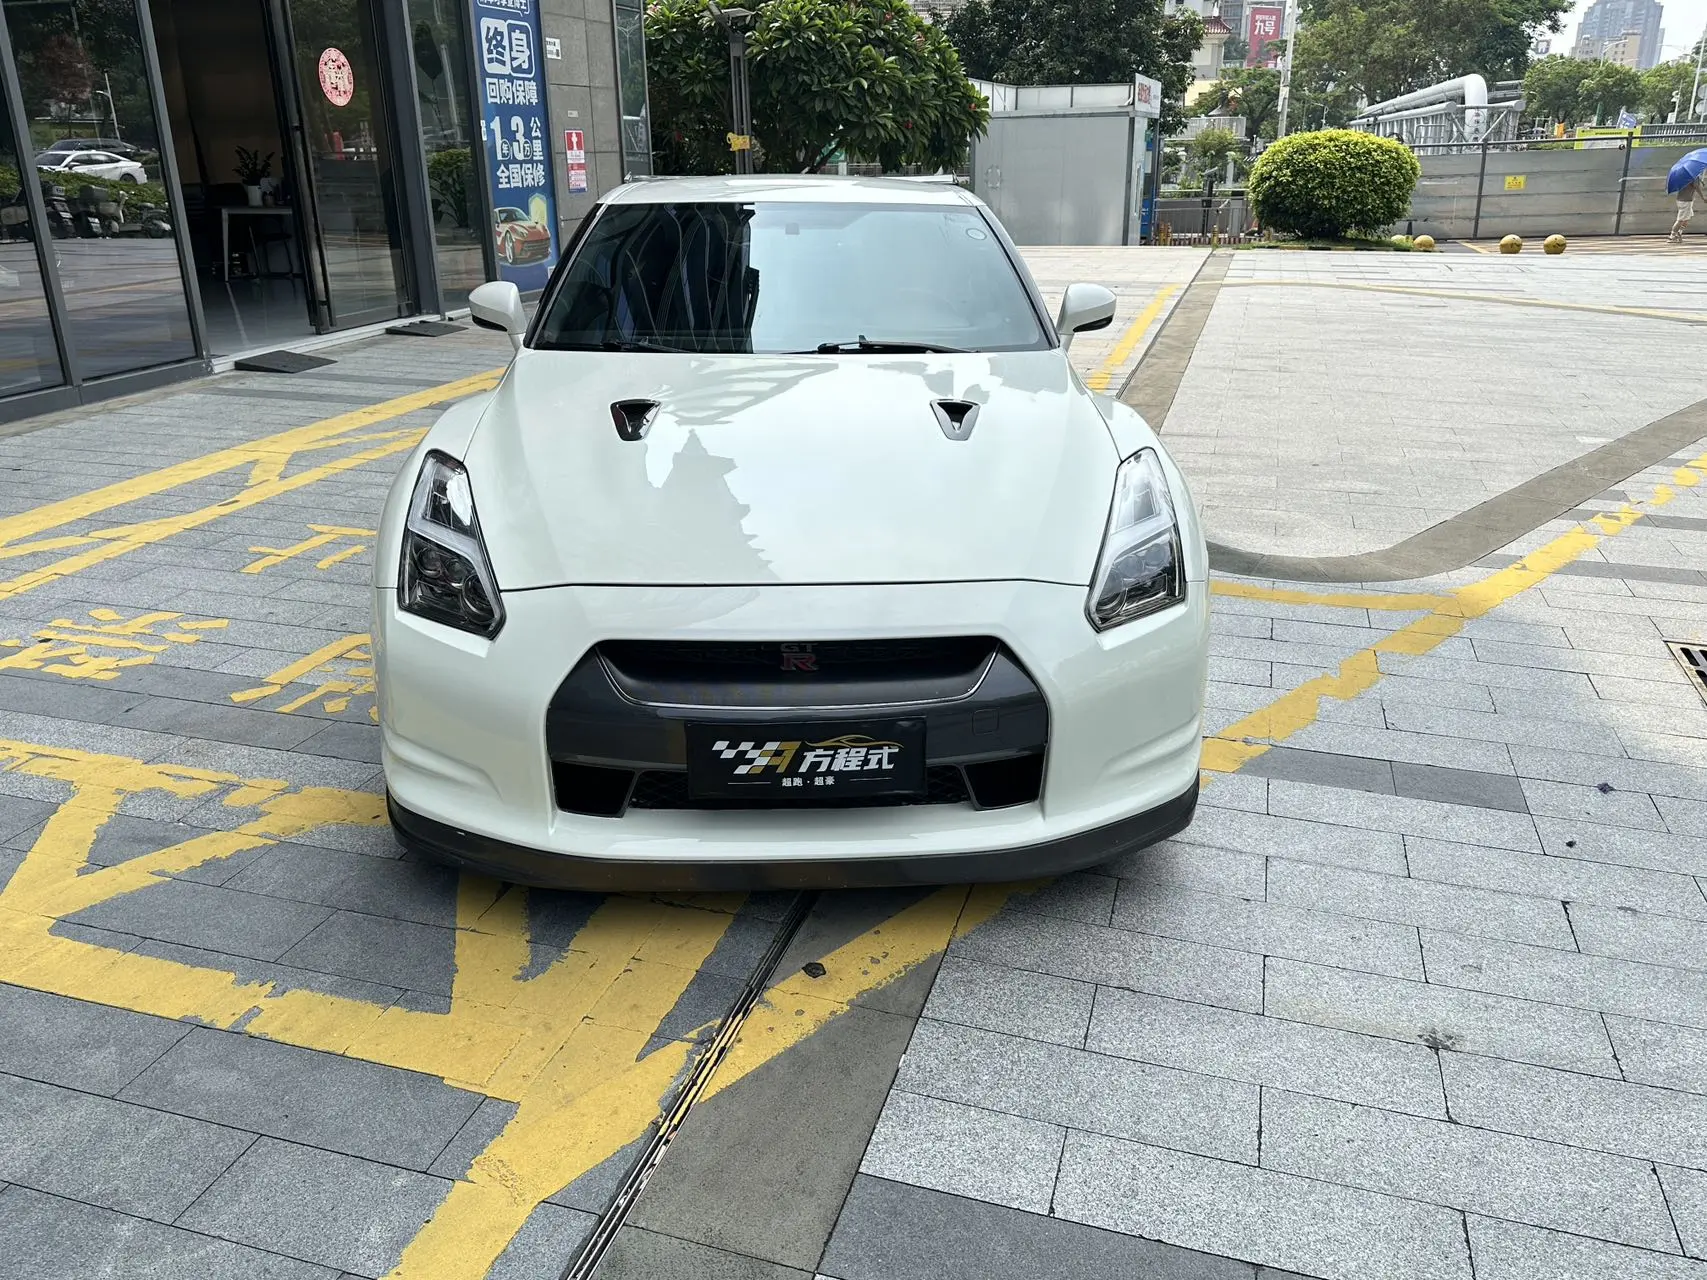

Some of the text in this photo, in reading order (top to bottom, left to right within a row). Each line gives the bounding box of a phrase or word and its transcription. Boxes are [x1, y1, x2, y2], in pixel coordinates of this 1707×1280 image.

[1254, 20, 1276, 35] 九号
[484, 25, 532, 72] 终身
[485, 78, 539, 106] 回购保障
[496, 163, 546, 189] 全国保修
[780, 643, 819, 653] GT
[780, 653, 820, 671] R
[797, 746, 900, 773] 方程式
